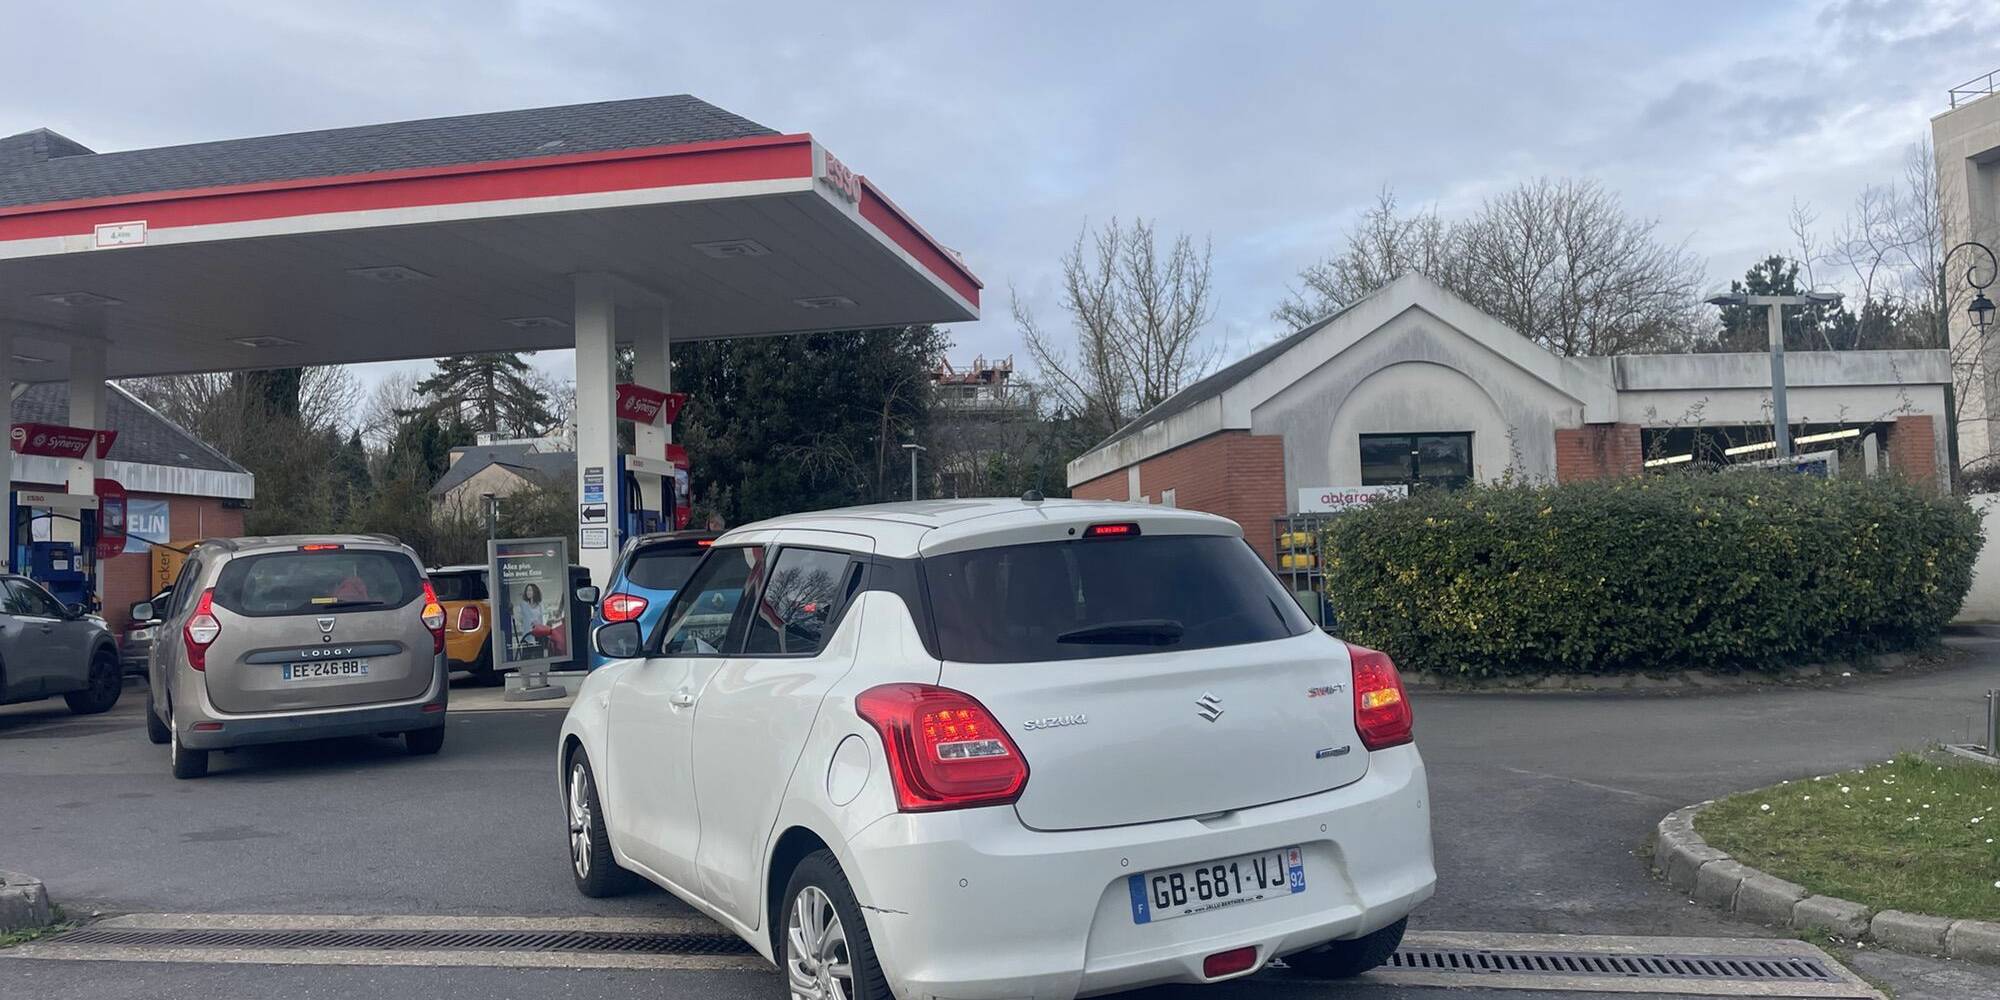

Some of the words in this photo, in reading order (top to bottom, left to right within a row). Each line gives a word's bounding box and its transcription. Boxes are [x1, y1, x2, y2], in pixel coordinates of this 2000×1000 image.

[47, 436, 87, 452] Synergy
[128, 514, 165, 533] ELIN
[158, 552, 170, 590] ocker
[301, 648, 352, 657] LODGY
[293, 661, 358, 678] EE-246-BB
[1024, 714, 1087, 730] SUZUKI
[1152, 854, 1286, 909] GB-681-VJ
[1291, 871, 1305, 888] 92
[1138, 903, 1144, 915] F
